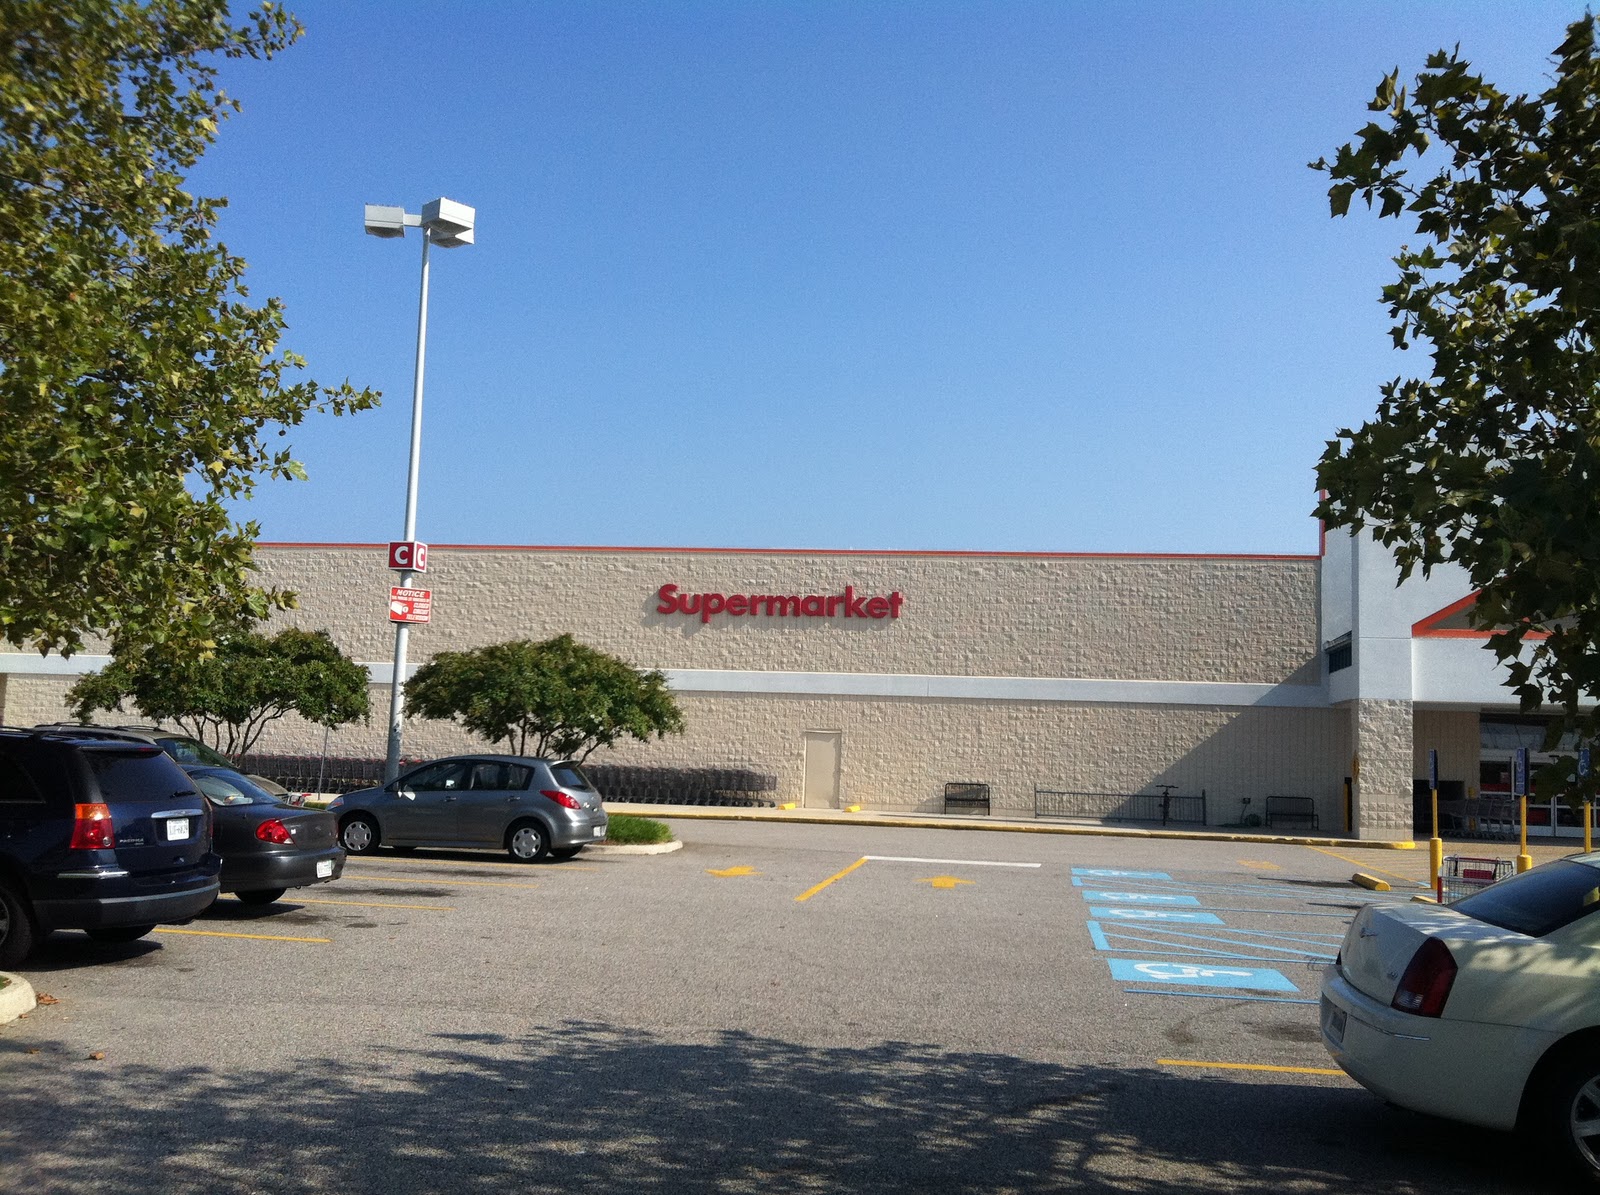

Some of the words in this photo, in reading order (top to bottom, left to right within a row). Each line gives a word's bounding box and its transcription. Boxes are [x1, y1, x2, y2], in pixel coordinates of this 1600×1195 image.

[395, 546, 408, 564] C
[417, 548, 425, 567] C
[397, 589, 425, 598] NOTICE
[657, 583, 903, 623] Supermarket
